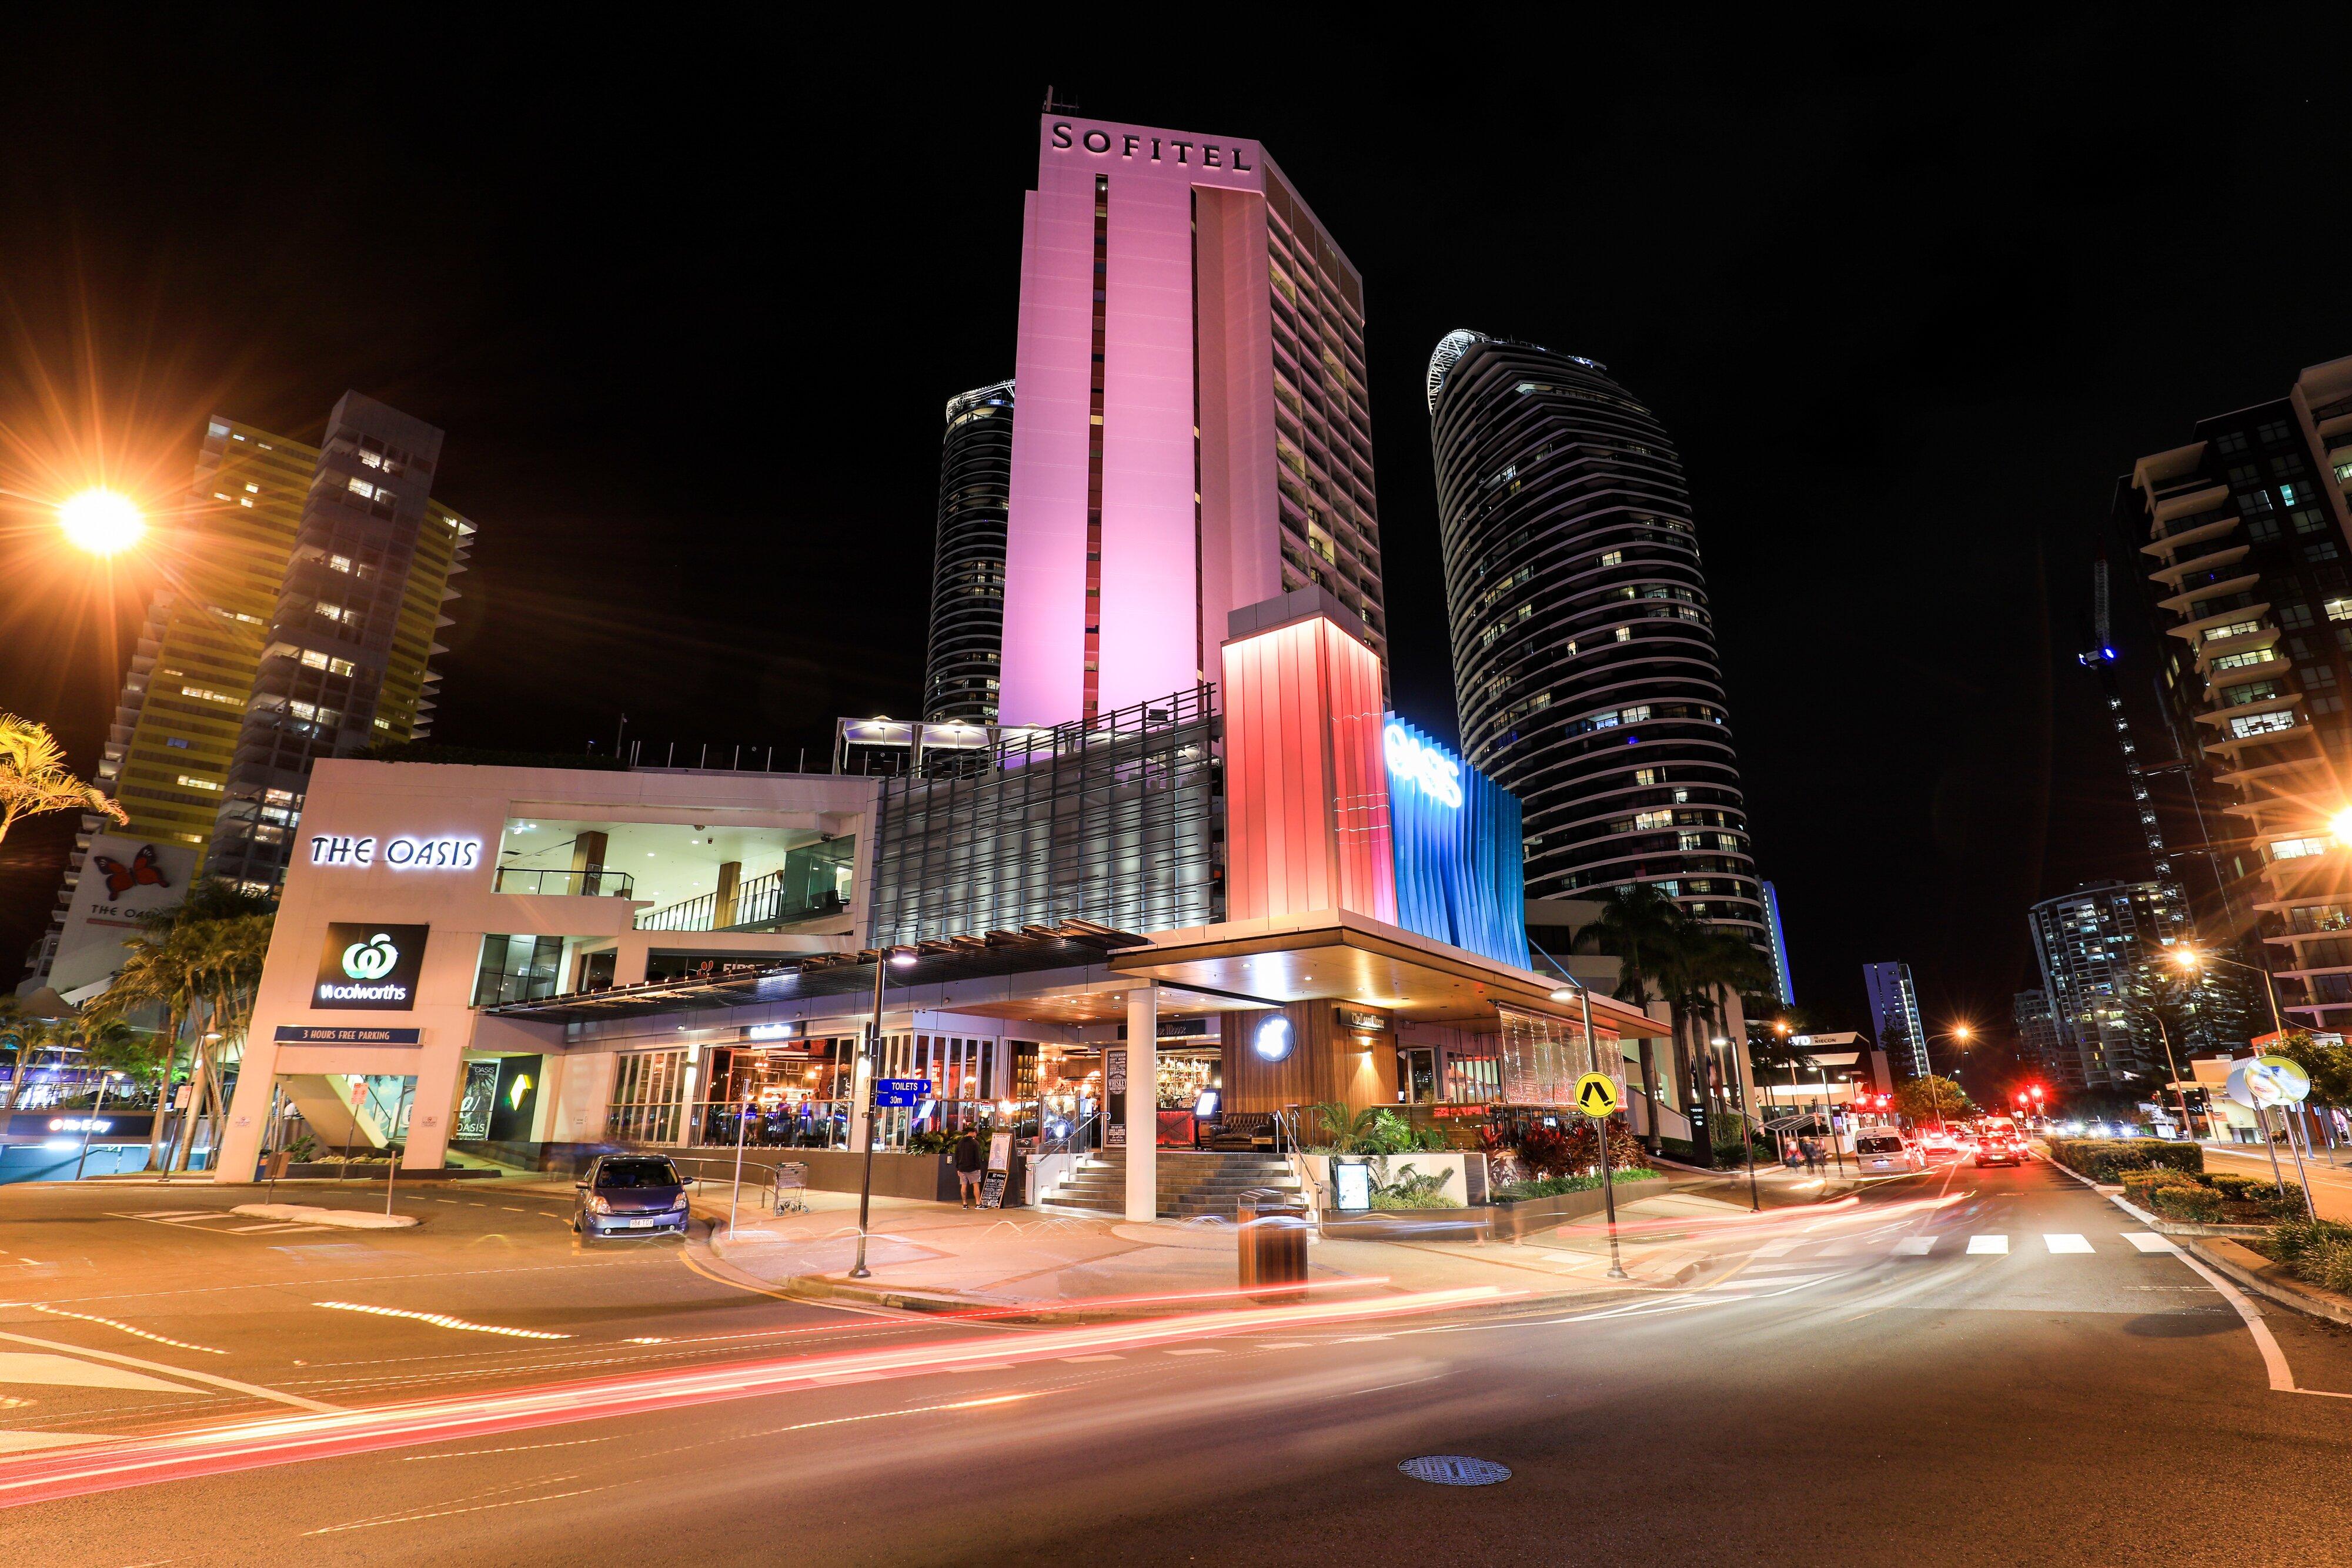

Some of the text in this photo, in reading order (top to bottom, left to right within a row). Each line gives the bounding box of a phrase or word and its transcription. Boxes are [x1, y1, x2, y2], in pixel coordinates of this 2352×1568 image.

[1052, 122, 1252, 172] SOFITEL
[312, 837, 477, 867] THE OASIS
[91, 904, 118, 916] THE
[723, 963, 764, 972] FIRS
[320, 983, 406, 1000] Woolworths
[302, 1029, 390, 1040] 3 HOURS FREE PARKING
[891, 1082, 918, 1091] TOILETS
[890, 1095, 903, 1104] 30m
